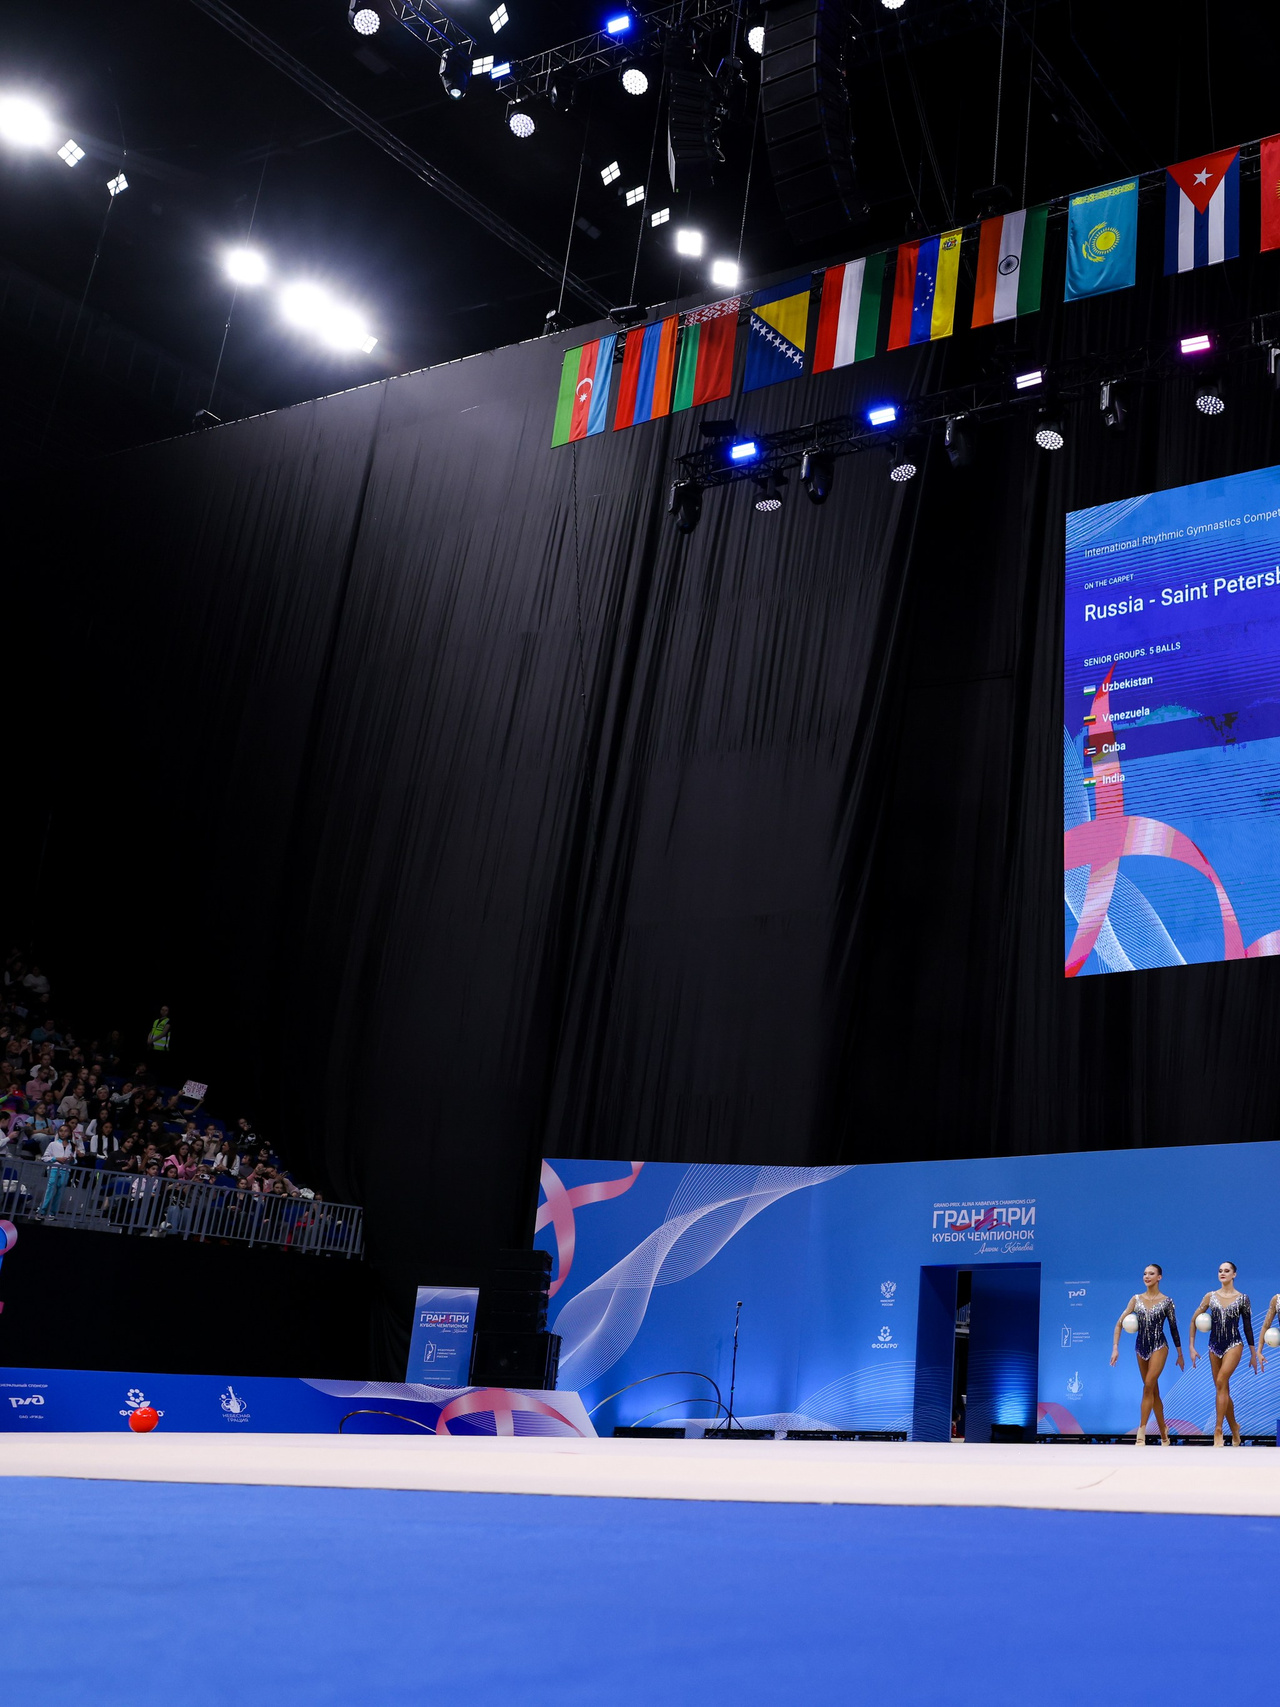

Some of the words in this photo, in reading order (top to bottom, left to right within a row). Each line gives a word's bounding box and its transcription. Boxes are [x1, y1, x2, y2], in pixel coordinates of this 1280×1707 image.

[1084, 537, 1140, 558] International
[1142, 529, 1184, 547] Rhythmic
[1187, 518, 1241, 537] Gymnastics
[1084, 582, 1094, 590] ON
[1095, 579, 1108, 588] THE
[1108, 573, 1134, 585] CARPET
[1084, 595, 1144, 622] Russia
[1161, 582, 1209, 607] Saint
[1083, 654, 1115, 667] SENIOR
[1113, 648, 1147, 662] GROUPS.
[1149, 646, 1155, 655] 5
[1155, 641, 1181, 654] BALLS
[1102, 676, 1153, 693] Uzbekistan
[1102, 706, 1150, 723] Venezuela
[1102, 741, 1126, 754] Cuba
[1102, 773, 1126, 785] India
[932, 1208, 985, 1229] ГРАН
[993, 1206, 1036, 1226] ПРИ
[932, 1232, 966, 1243] КУБОК
[967, 1229, 1035, 1242] ЧЕМПИОНОК
[420, 1313, 446, 1323] ГРАН
[449, 1314, 470, 1323] ПРИ
